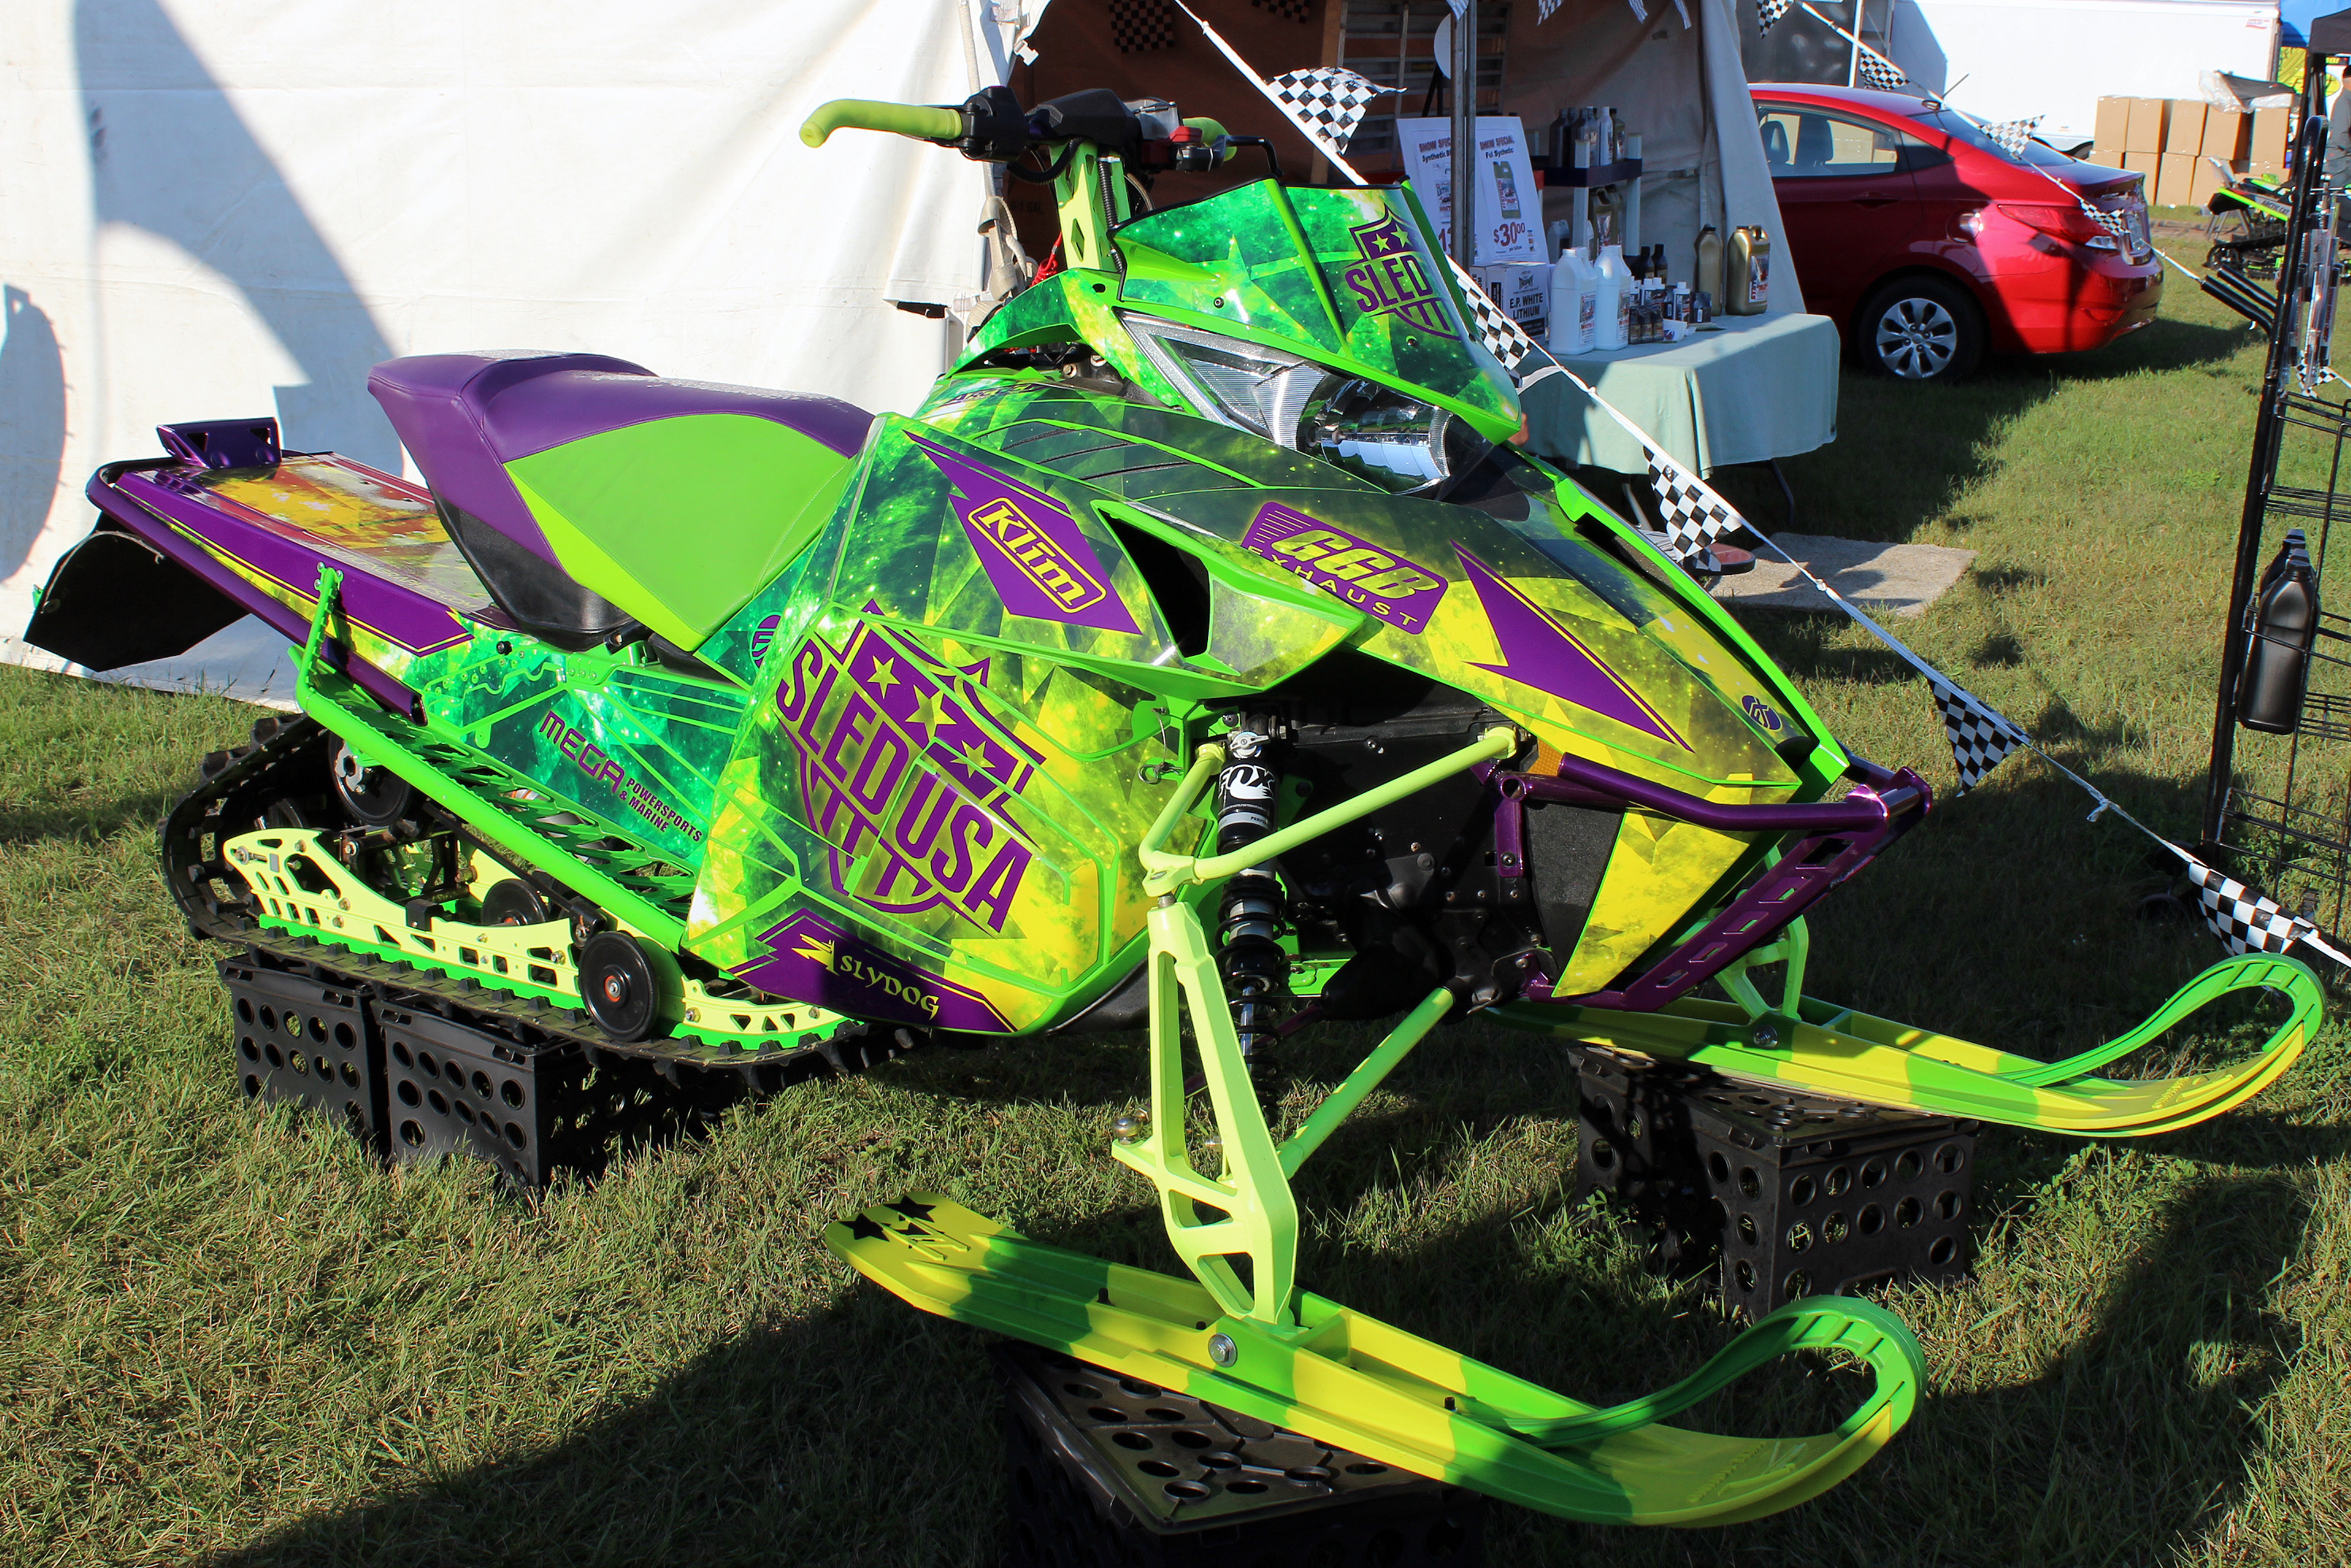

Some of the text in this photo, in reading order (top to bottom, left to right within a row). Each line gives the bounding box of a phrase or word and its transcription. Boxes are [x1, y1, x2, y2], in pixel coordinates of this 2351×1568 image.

[1422, 151, 1445, 163] Synthetic
[1344, 255, 1433, 312] SLED
[1509, 293, 1543, 309] E.P. WHITE
[1513, 305, 1540, 320] LITHIUM
[1248, 545, 1418, 626] EXHAUST
[1271, 529, 1440, 600] GGB
[539, 711, 625, 793] MEGA
[626, 777, 703, 842] POWERSPORTS
[776, 639, 1033, 934] SLED USA
[1218, 764, 1275, 799] FOX
[619, 790, 669, 833] & MARINE
